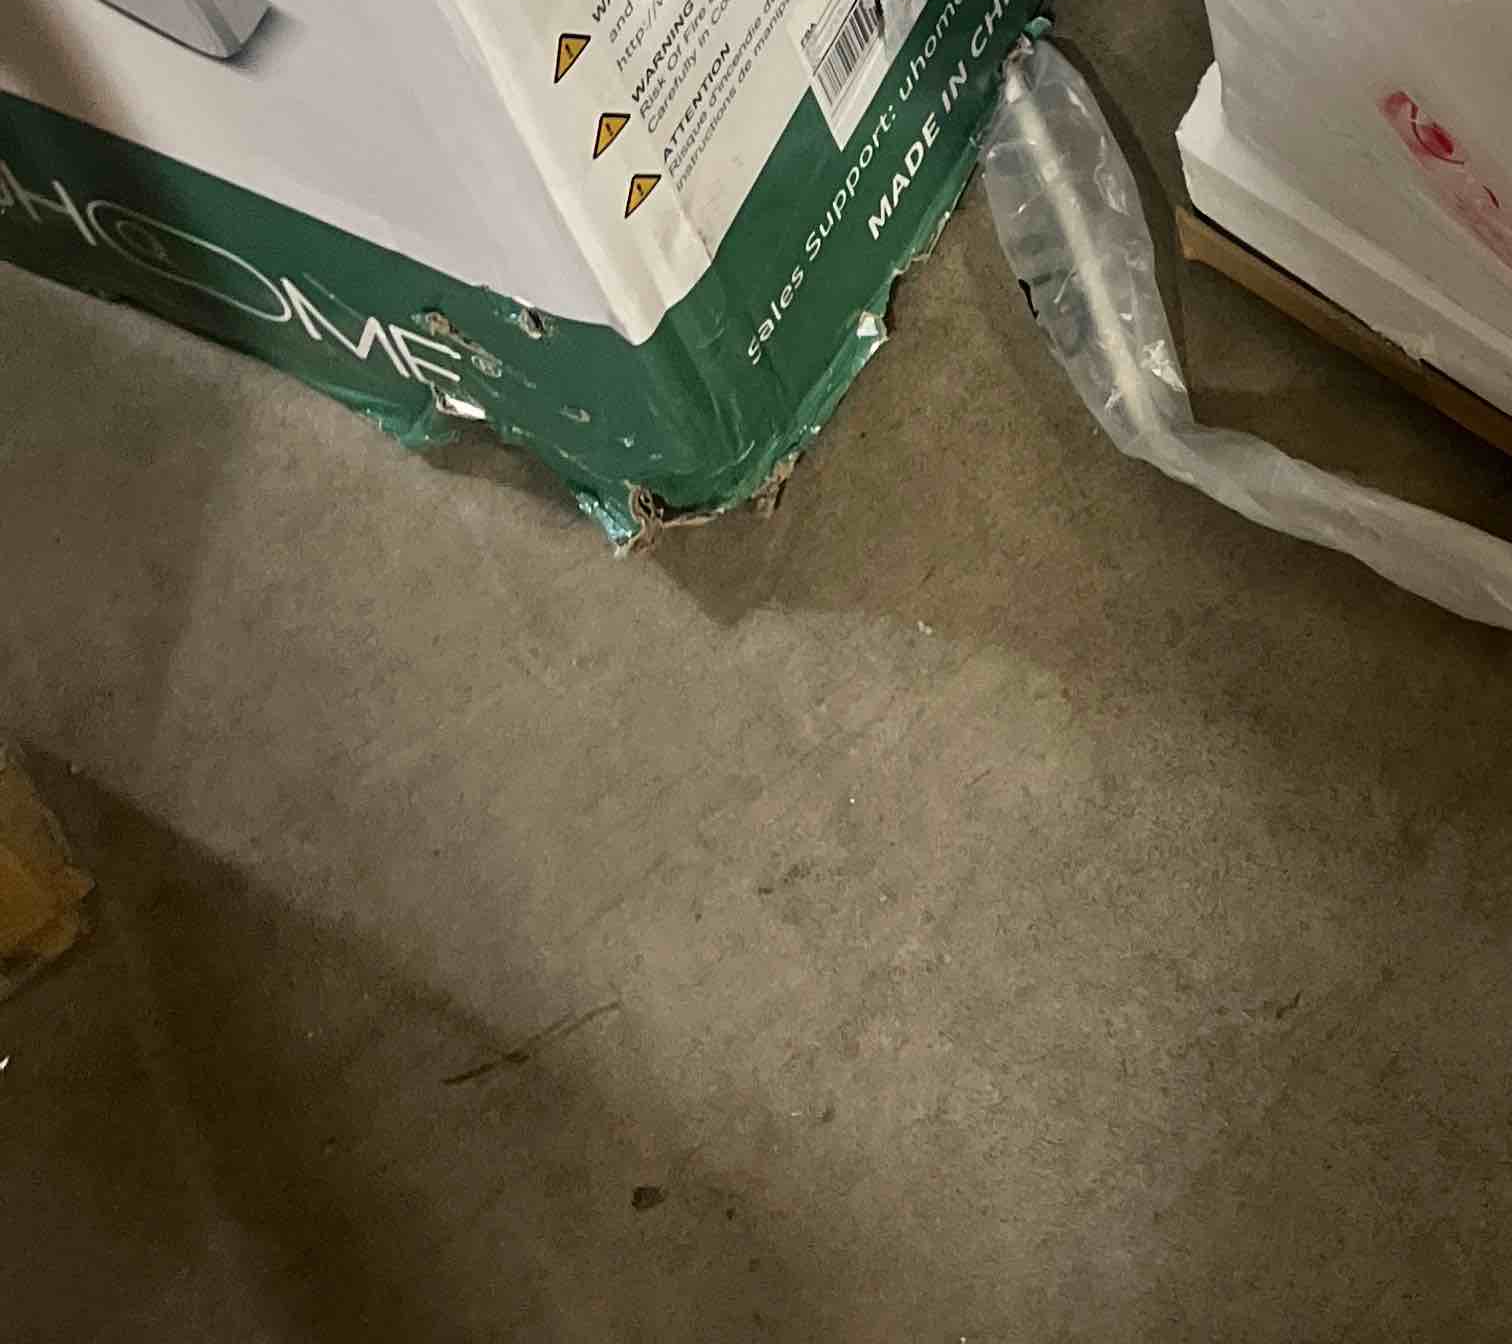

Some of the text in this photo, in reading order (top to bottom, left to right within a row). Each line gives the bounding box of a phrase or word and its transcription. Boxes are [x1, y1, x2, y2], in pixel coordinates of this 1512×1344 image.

[631, 0, 694, 104] WARNING
[639, 77, 667, 121] Risk
[667, 43, 684, 72] Of
[683, 7, 706, 45] Fire
[646, 49, 698, 135] Carefully
[698, 26, 711, 50] in
[662, 42, 731, 164] ATTENTION
[737, 60, 752, 85] de
[668, 111, 707, 178] Risque
[804, 104, 897, 262] Support:
[867, 112, 941, 241] MADE
[941, 62, 970, 114] IN
[0, 160, 461, 382] HOME
